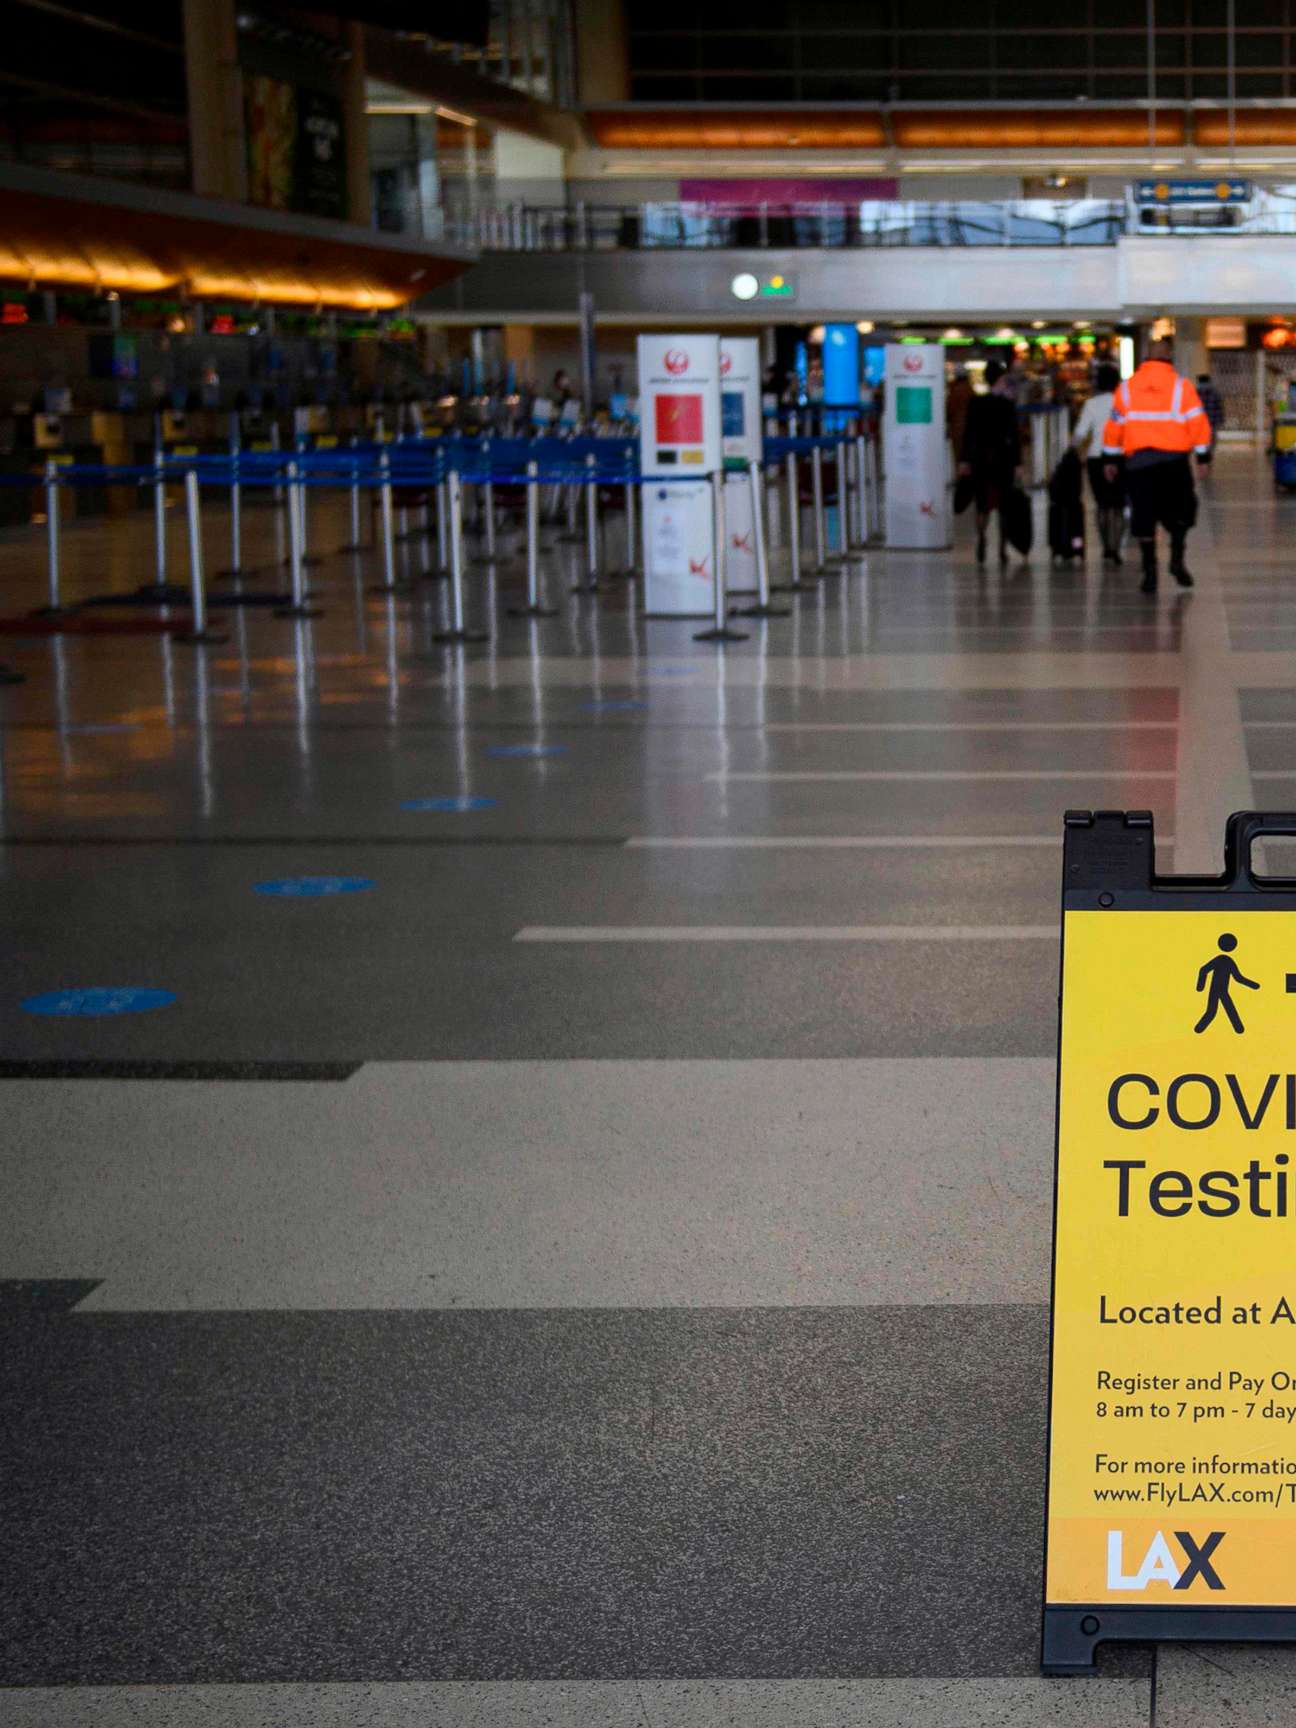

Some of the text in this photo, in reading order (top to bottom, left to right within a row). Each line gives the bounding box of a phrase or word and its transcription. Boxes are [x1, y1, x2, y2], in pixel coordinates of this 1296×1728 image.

[1099, 1295, 1222, 1324] Located
[1232, 1302, 1262, 1325] at
[1097, 1370, 1180, 1395] Register
[1185, 1371, 1222, 1391] and
[1229, 1371, 1265, 1396] Pay
[1096, 1401, 1107, 1418] 8
[1113, 1405, 1144, 1418] am
[1150, 1403, 1170, 1418] to
[1176, 1402, 1187, 1418] 7
[1193, 1406, 1225, 1423] pm
[1245, 1402, 1256, 1418] 7
[1095, 1453, 1128, 1473] For
[1134, 1461, 1186, 1474] more
[1107, 1531, 1226, 1590] LAX
